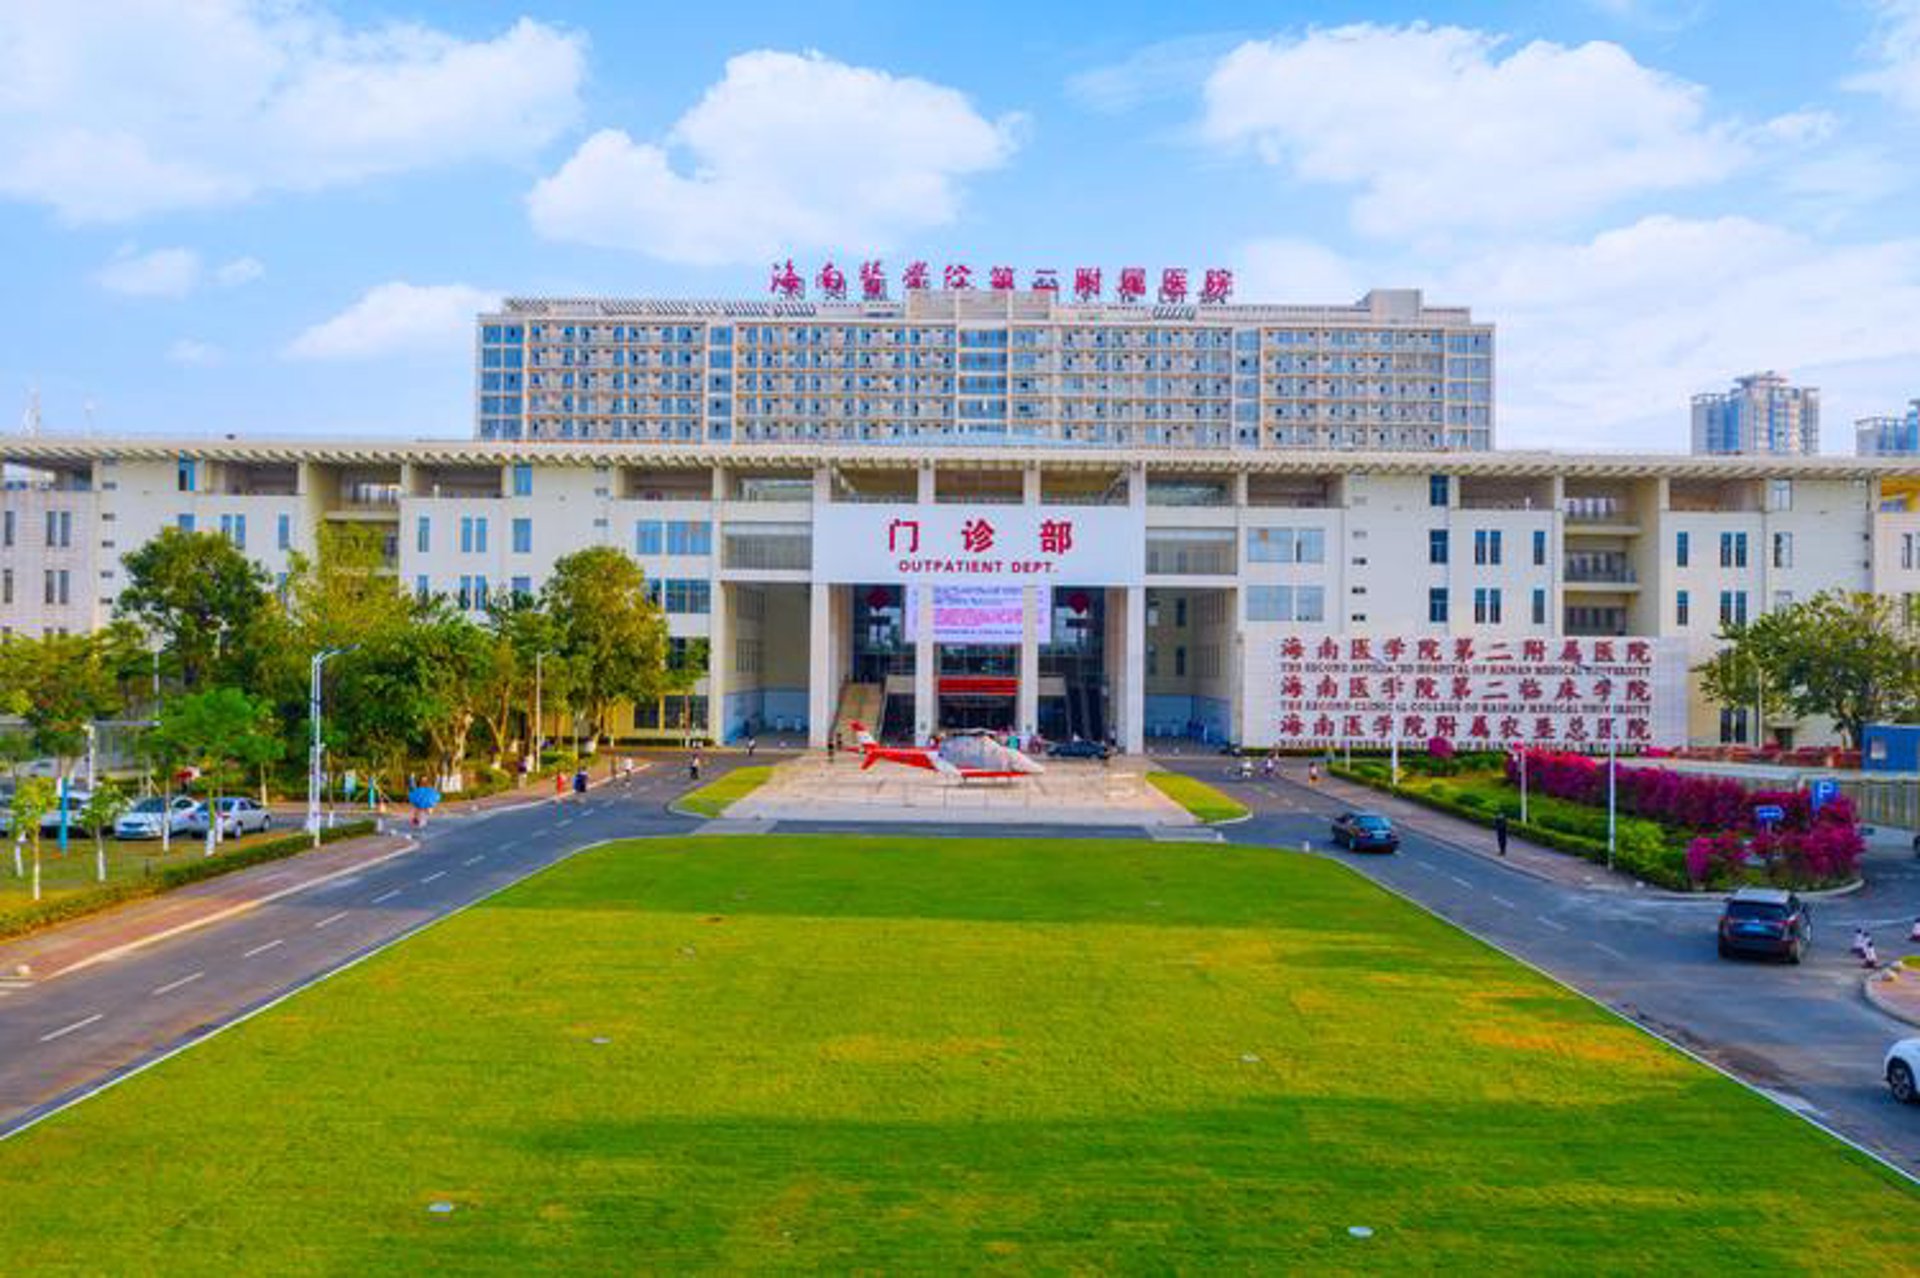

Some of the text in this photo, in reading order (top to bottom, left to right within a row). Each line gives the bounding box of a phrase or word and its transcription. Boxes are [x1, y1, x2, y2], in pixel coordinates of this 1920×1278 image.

[889, 518, 1073, 554] 门诊部
[899, 560, 1059, 574] OUTPATIENT DEPT.
[1281, 636, 1651, 664] 海南医学院第二附属医院
[1281, 675, 1651, 702] 海南医学院第二临床学院
[1281, 713, 1651, 741] 海南医学院附属农垦总医院
[1819, 782, 1834, 798] P
